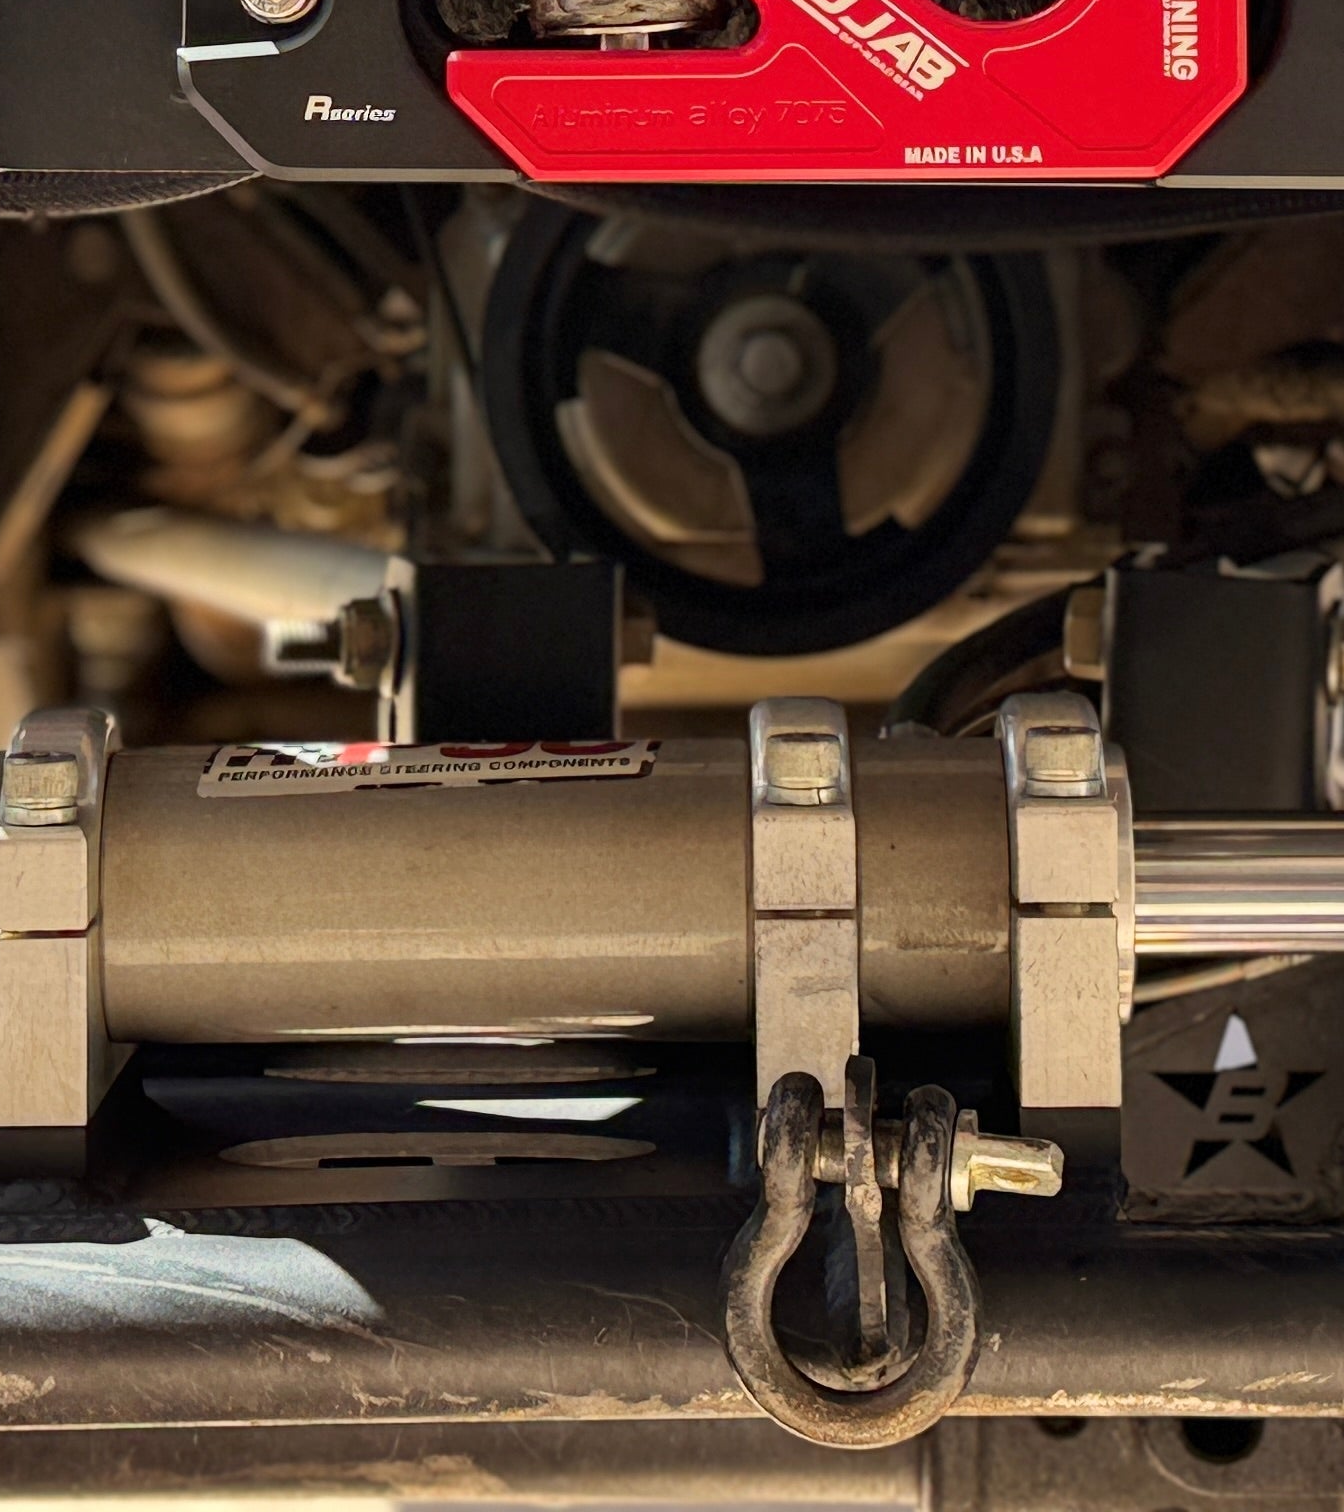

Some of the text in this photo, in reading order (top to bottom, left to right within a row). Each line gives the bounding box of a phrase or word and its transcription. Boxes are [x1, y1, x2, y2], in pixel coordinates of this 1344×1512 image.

[529, 101, 675, 128] Aluminum
[774, 100, 847, 125] 7075
[905, 147, 960, 164] MADE
[965, 146, 986, 164] IN
[218, 757, 631, 782] PERFORMANCE STEERING COMPONENTS
